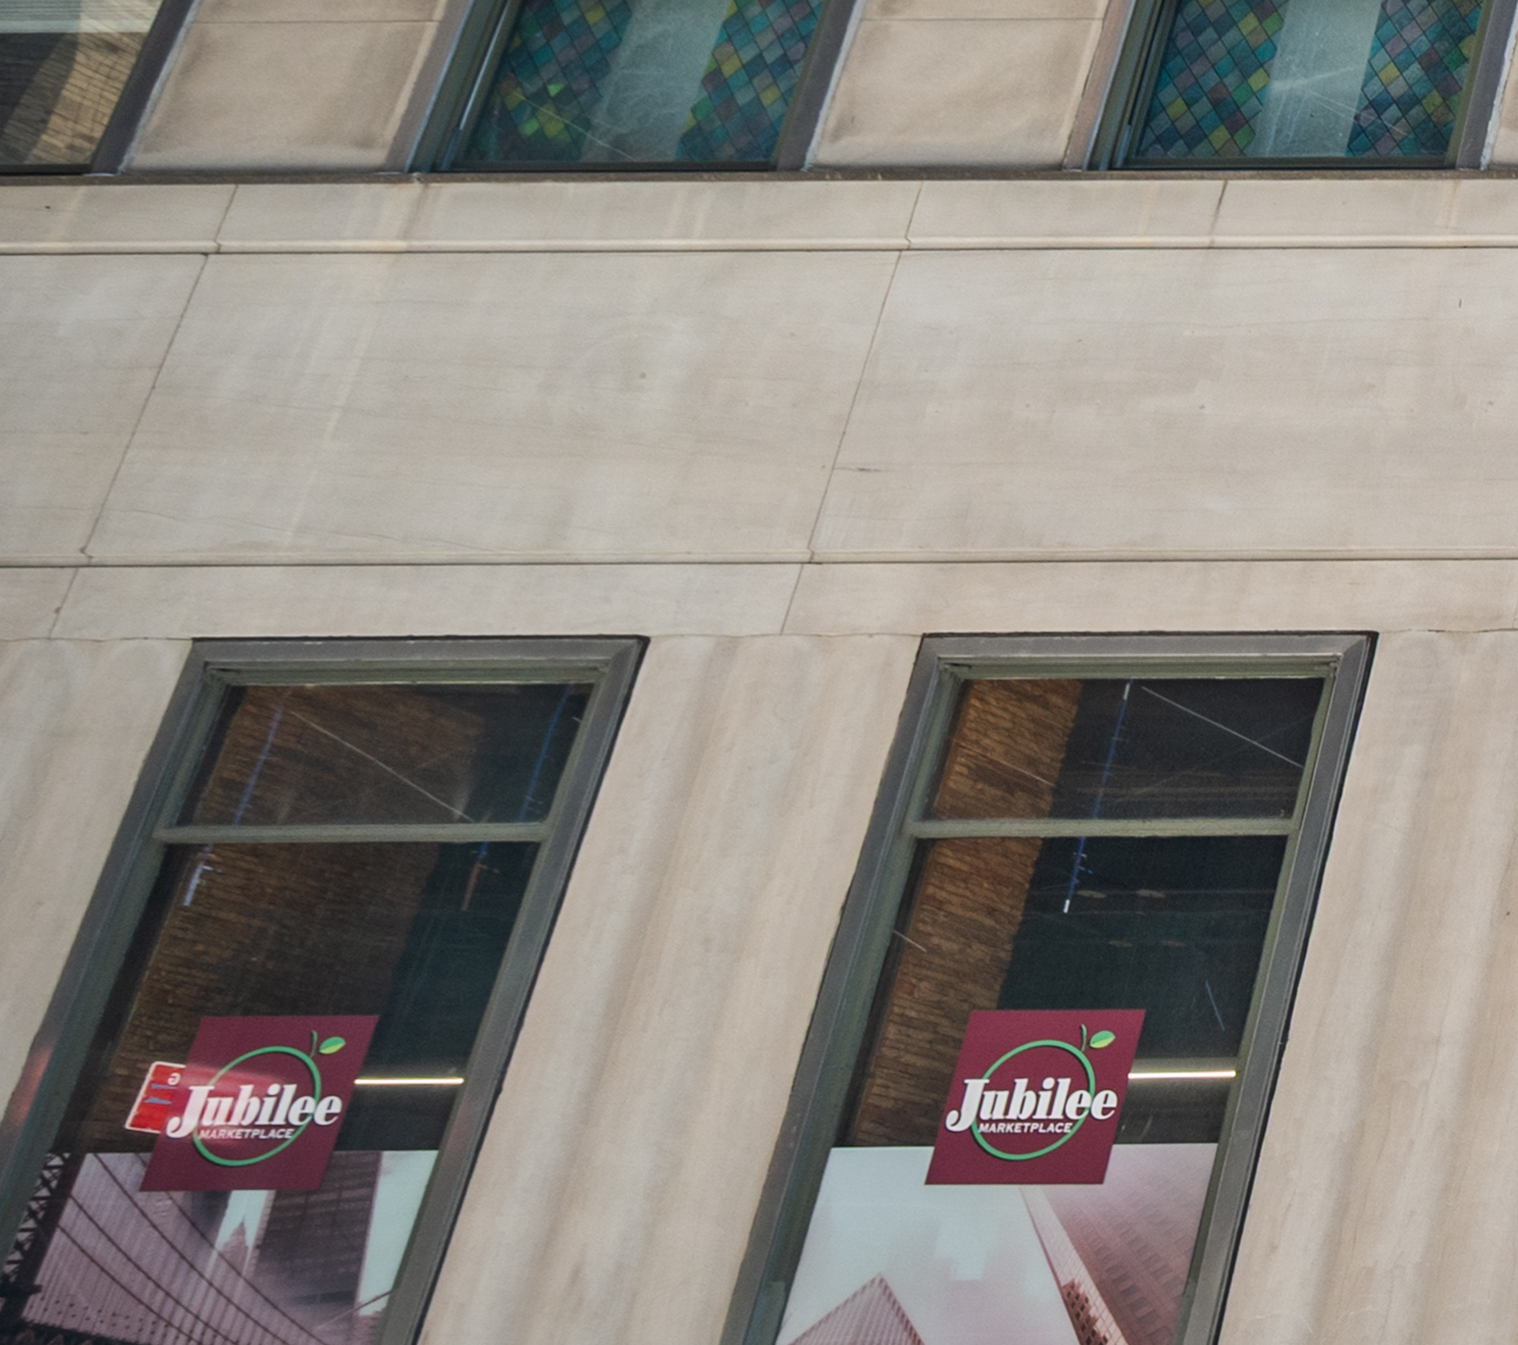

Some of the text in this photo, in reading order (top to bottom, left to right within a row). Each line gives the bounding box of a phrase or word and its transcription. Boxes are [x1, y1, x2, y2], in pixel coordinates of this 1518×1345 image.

[166, 1083, 342, 1138] Jubilee
[945, 1077, 1118, 1132] Jubilee
[199, 1128, 295, 1139] MARKETPLACE
[978, 1123, 1073, 1133] MARKETPLACE
